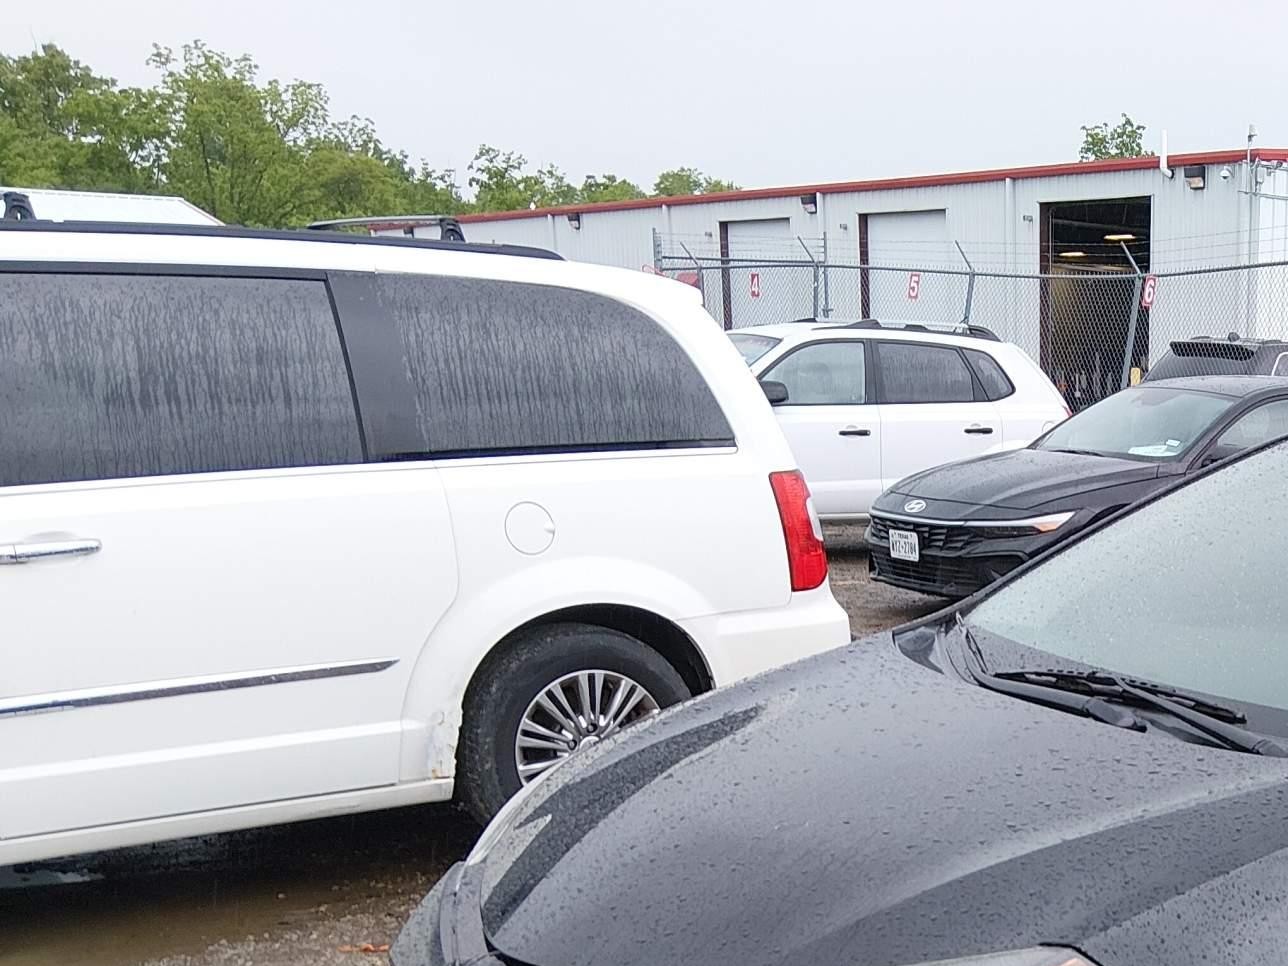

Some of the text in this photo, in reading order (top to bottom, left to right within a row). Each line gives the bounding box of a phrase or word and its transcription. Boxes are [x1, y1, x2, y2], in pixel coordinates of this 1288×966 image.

[751, 274, 759, 295] 4
[909, 275, 919, 297] 5
[1144, 279, 1154, 304] 6
